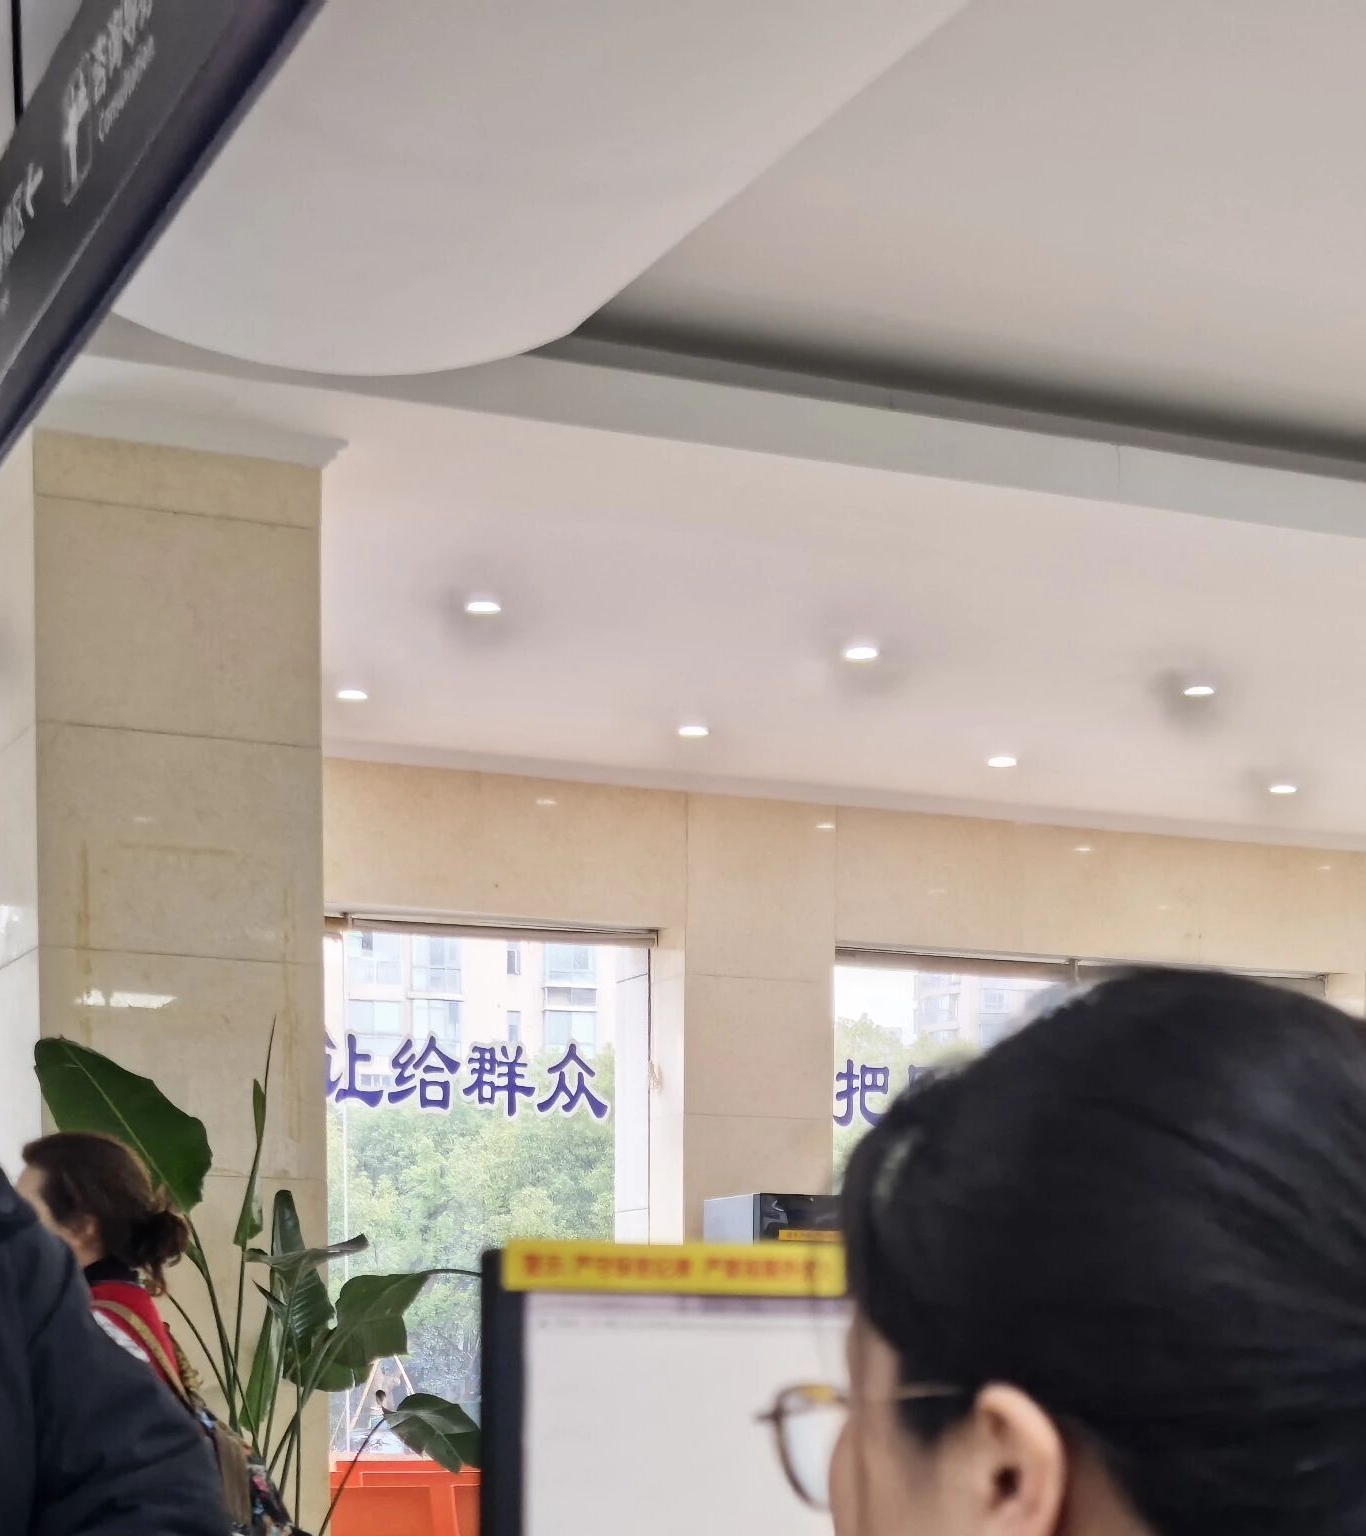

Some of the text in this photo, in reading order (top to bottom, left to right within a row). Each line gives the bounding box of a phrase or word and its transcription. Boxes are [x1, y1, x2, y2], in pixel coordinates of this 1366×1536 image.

[325, 1033, 609, 1118] 让给群众
[833, 1058, 935, 1128] 把
